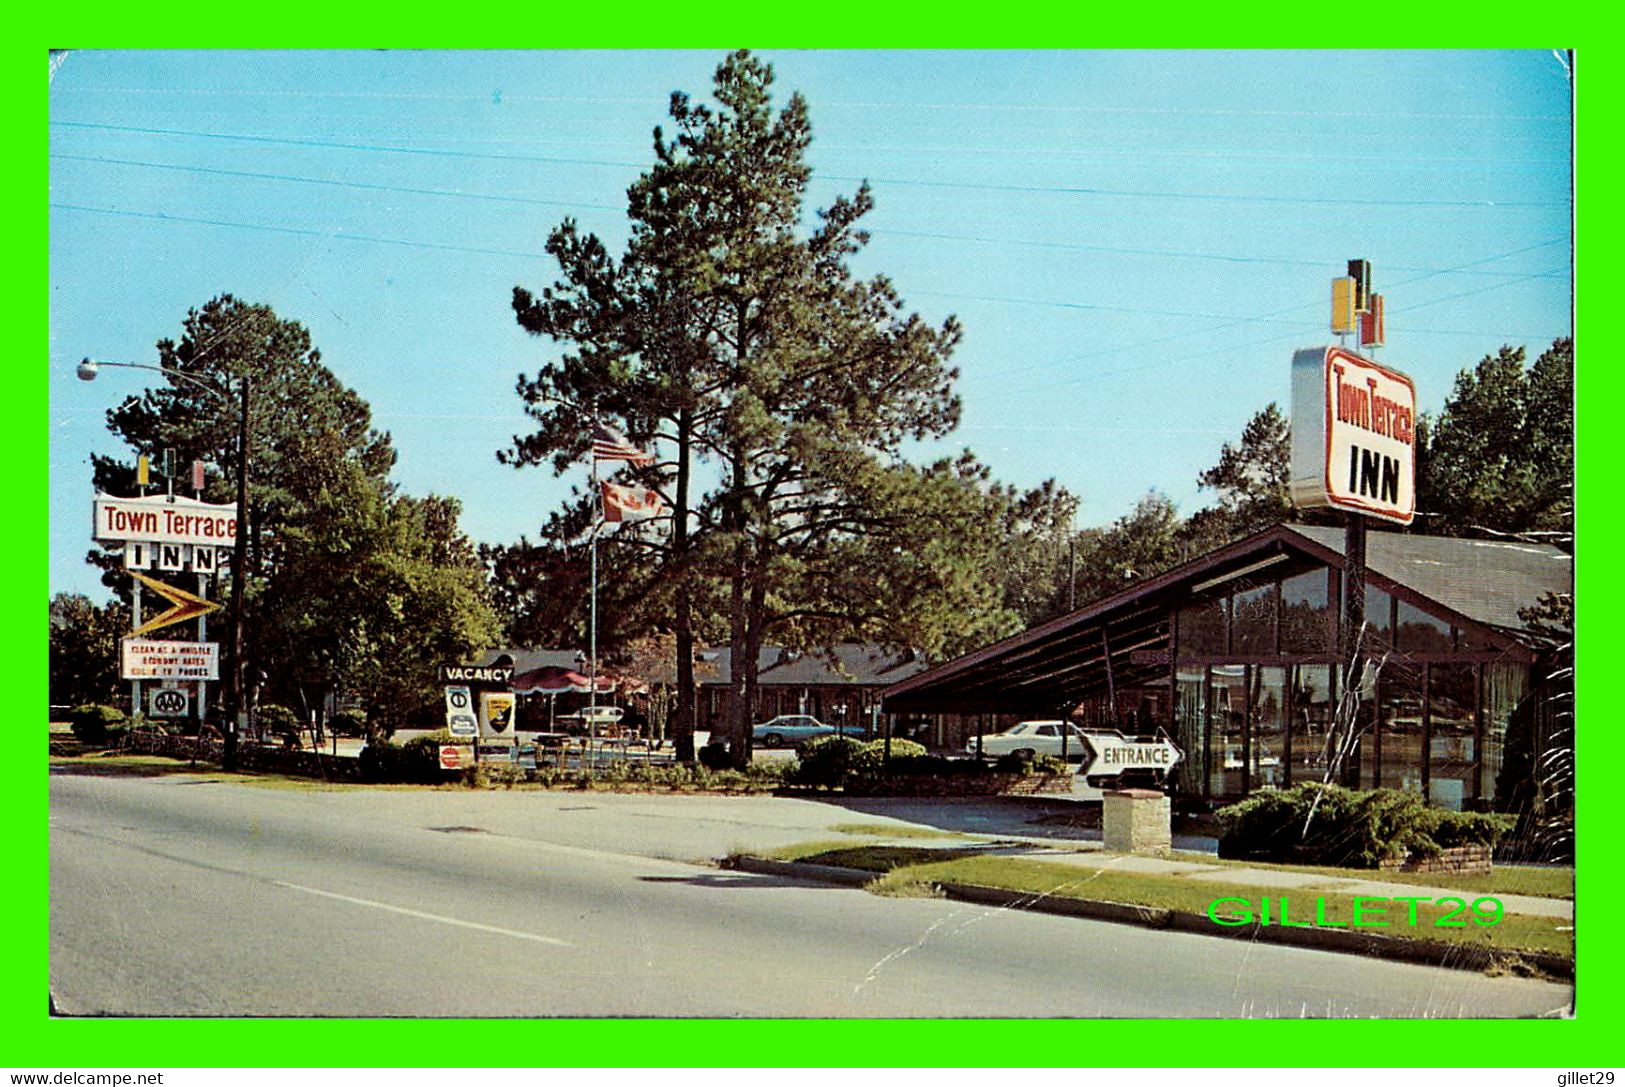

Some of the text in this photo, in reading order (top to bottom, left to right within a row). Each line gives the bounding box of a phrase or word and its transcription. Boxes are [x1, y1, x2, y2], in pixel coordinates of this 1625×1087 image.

[1333, 363, 1411, 445] Town Terrace
[1350, 445, 1400, 505] INN
[104, 506, 237, 538] Town Terrace
[135, 544, 212, 570] INN
[131, 645, 155, 654] CLEAN
[171, 646, 176, 654] A
[143, 656, 206, 666] ECONOMY RATES
[163, 667, 172, 676] TV
[178, 668, 209, 677] PHONES
[446, 667, 513, 681] VACANCY
[156, 691, 185, 713] AAA
[1103, 747, 1169, 764] ENTRANCE
